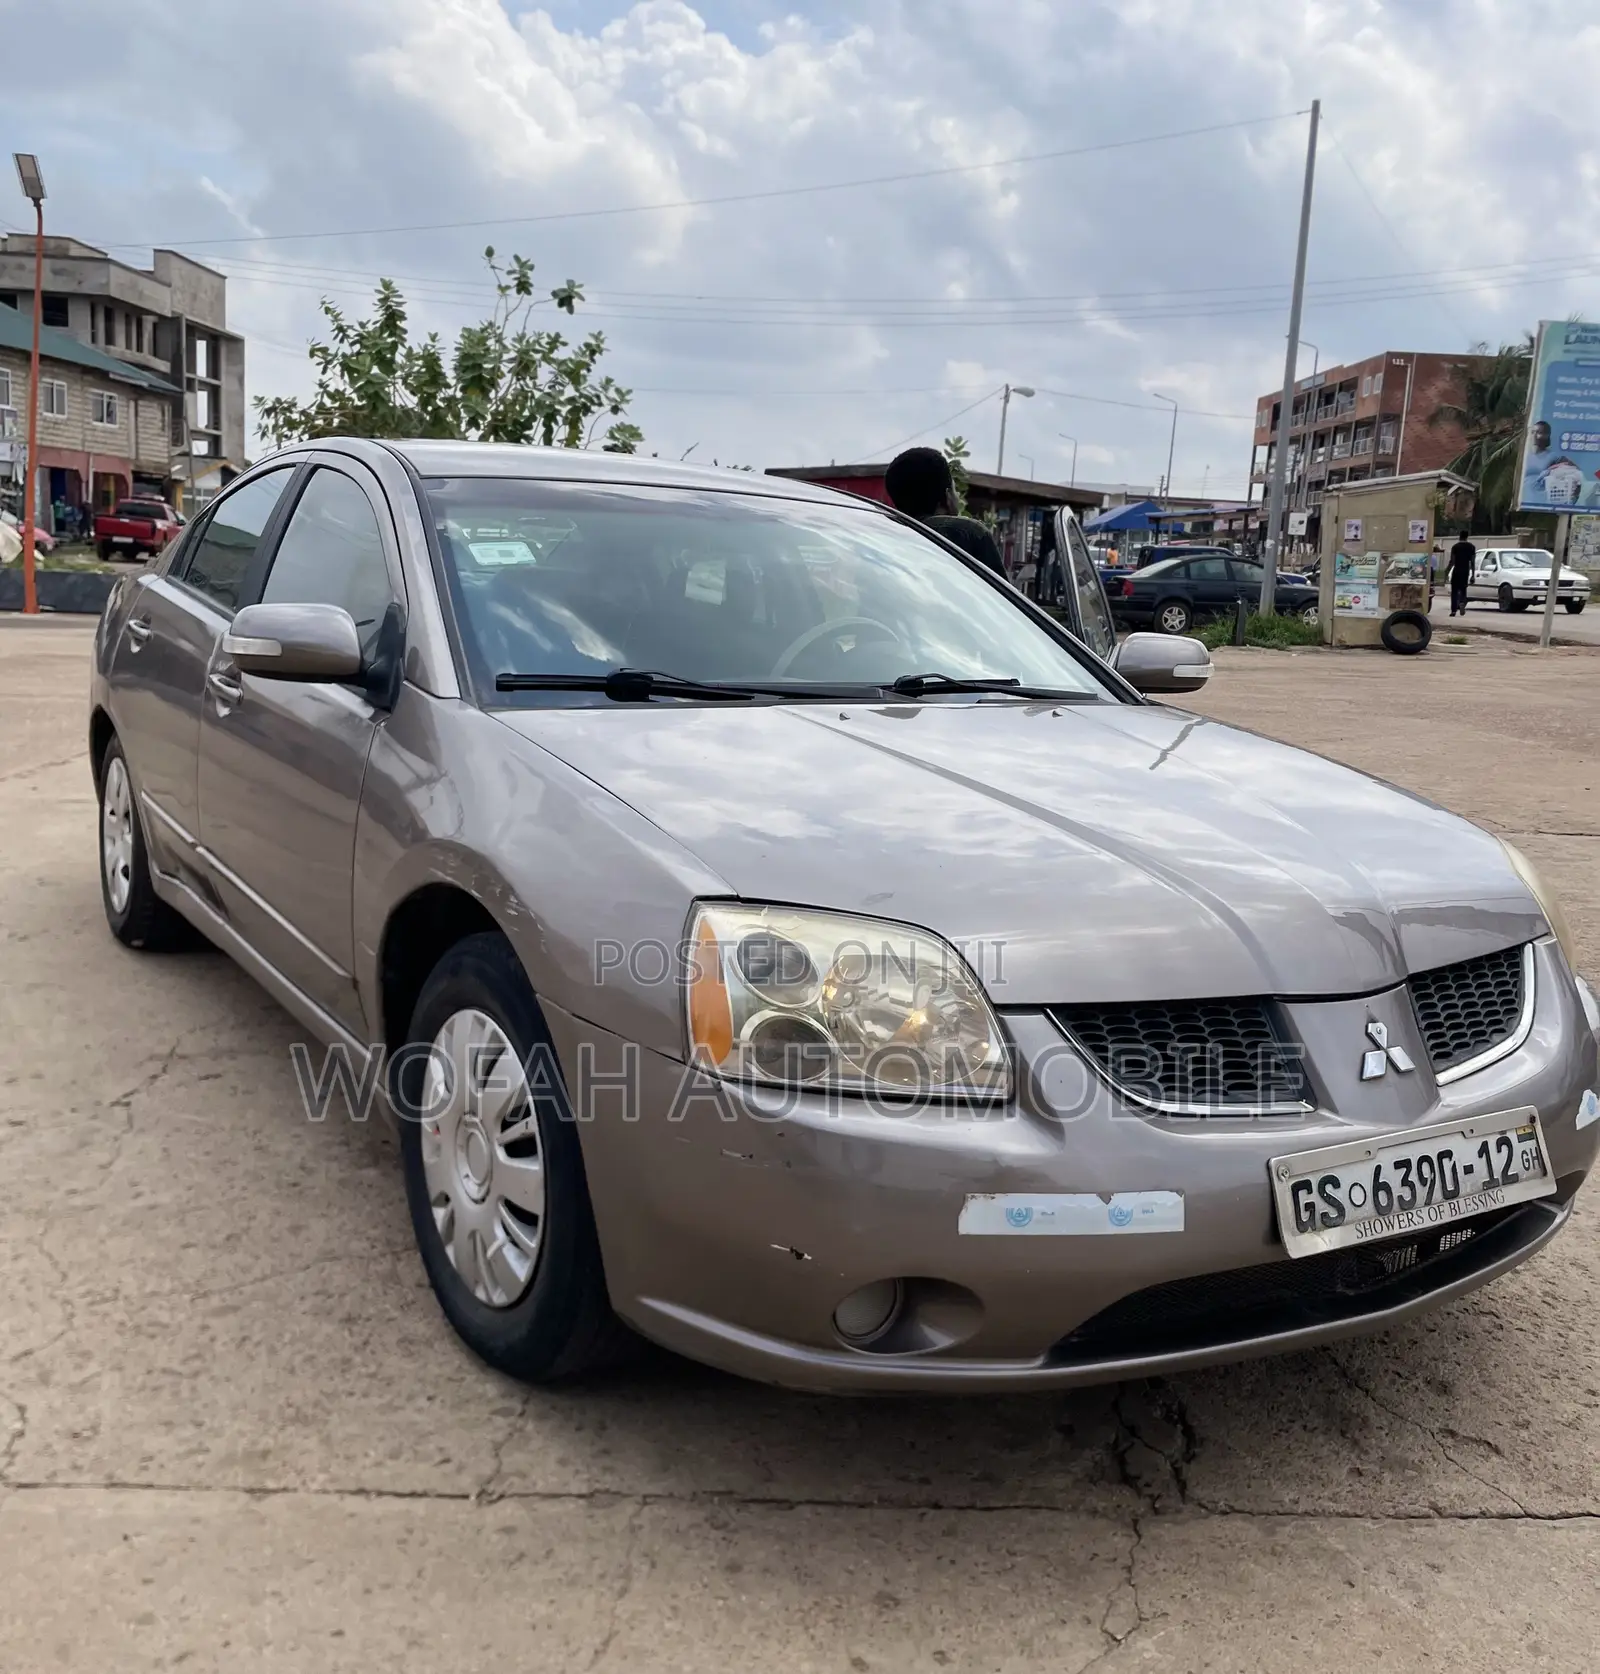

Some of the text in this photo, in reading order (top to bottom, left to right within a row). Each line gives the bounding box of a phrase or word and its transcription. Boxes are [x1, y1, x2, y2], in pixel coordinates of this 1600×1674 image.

[1521, 1146, 1542, 1171] GH
[1291, 1174, 1346, 1233] GS
[1355, 1188, 1506, 1239] SHOWERS OF BLESSING
